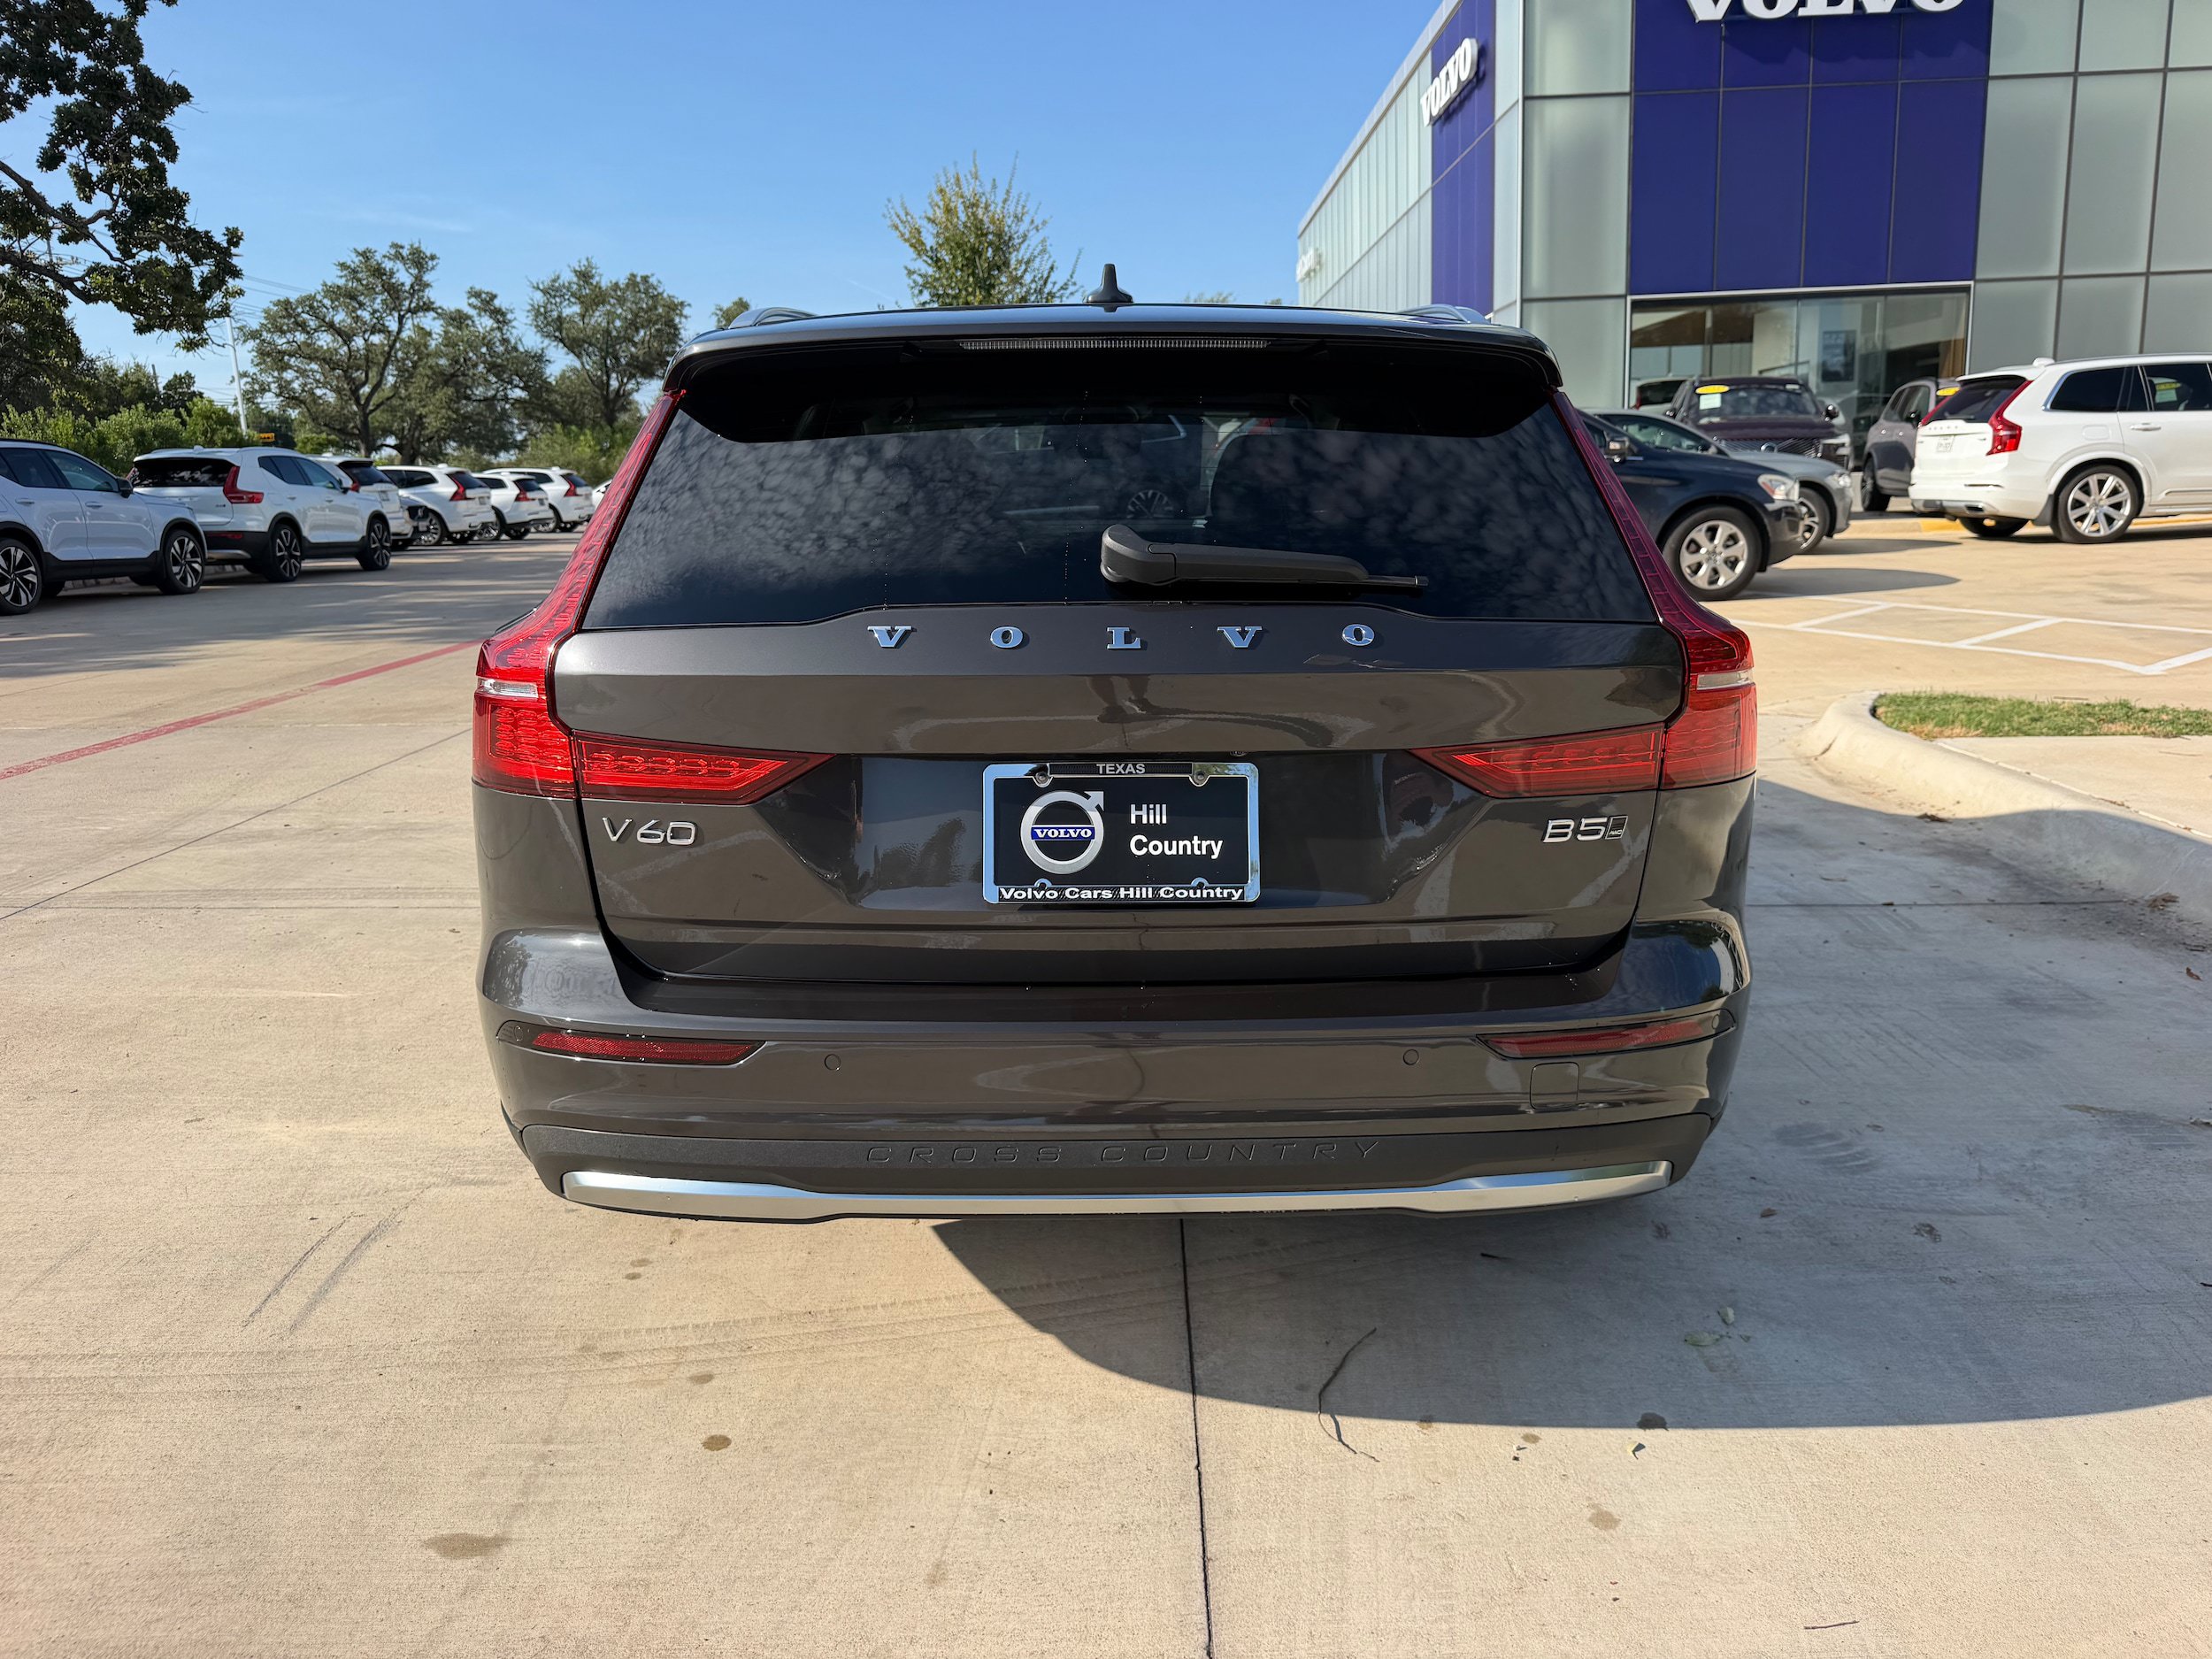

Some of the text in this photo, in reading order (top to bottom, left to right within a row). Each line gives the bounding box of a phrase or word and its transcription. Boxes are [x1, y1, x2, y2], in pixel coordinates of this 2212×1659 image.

[1420, 38, 1472, 127] VOLVO
[868, 624, 1376, 649] VOLVO
[1096, 763, 1146, 774] TEXAS
[1130, 804, 1167, 824] Hill
[603, 817, 696, 845] V60
[1033, 828, 1093, 838] VOLVO
[1542, 817, 1608, 843] B5
[1129, 835, 1223, 859] Country
[1000, 887, 1243, 901] Volvo Cars Hill Country
[867, 1141, 1379, 1164] CROSS COUNTRY
